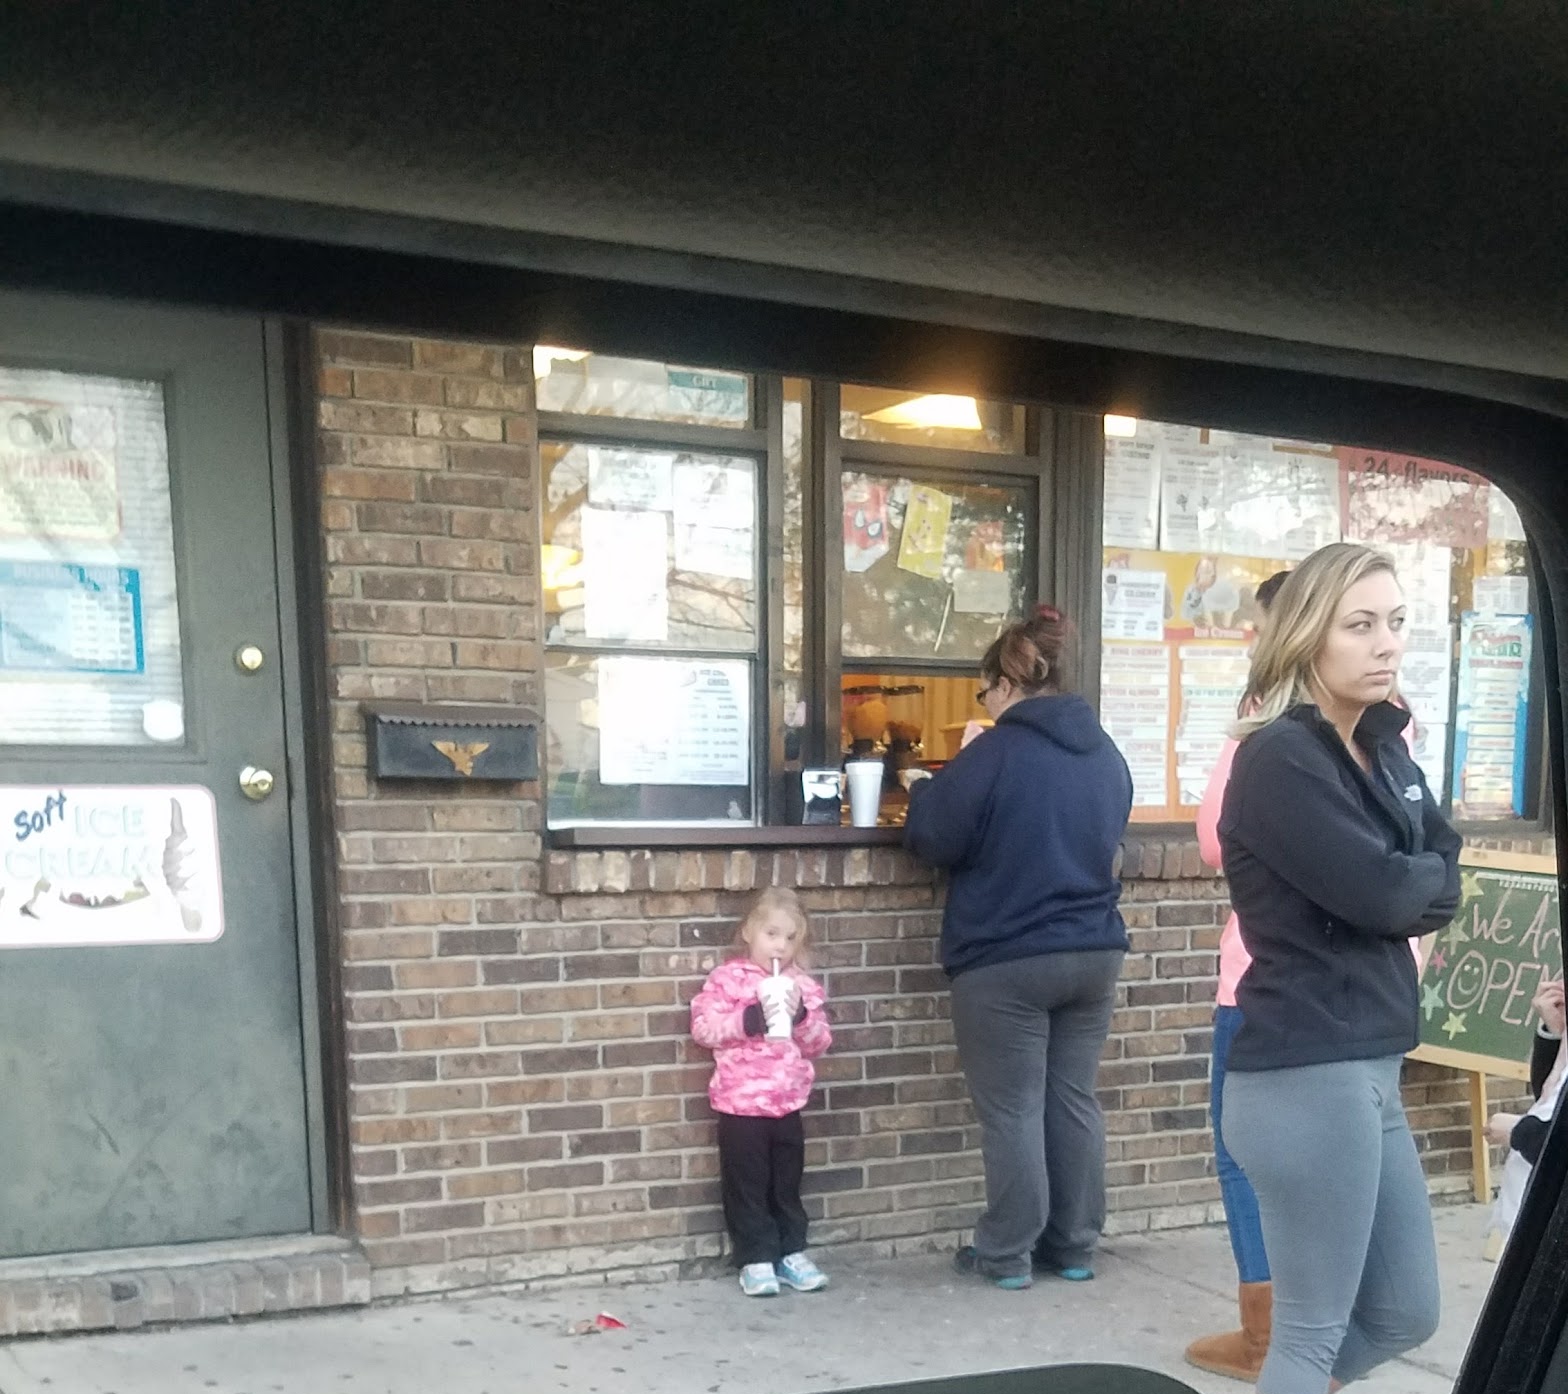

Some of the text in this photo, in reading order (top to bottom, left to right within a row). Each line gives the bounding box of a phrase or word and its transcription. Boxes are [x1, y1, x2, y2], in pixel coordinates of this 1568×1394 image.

[1363, 456, 1389, 477] 24
[74, 804, 146, 838] ICE
[5, 844, 160, 879] CREAM
[1472, 887, 1562, 959] We Ar
